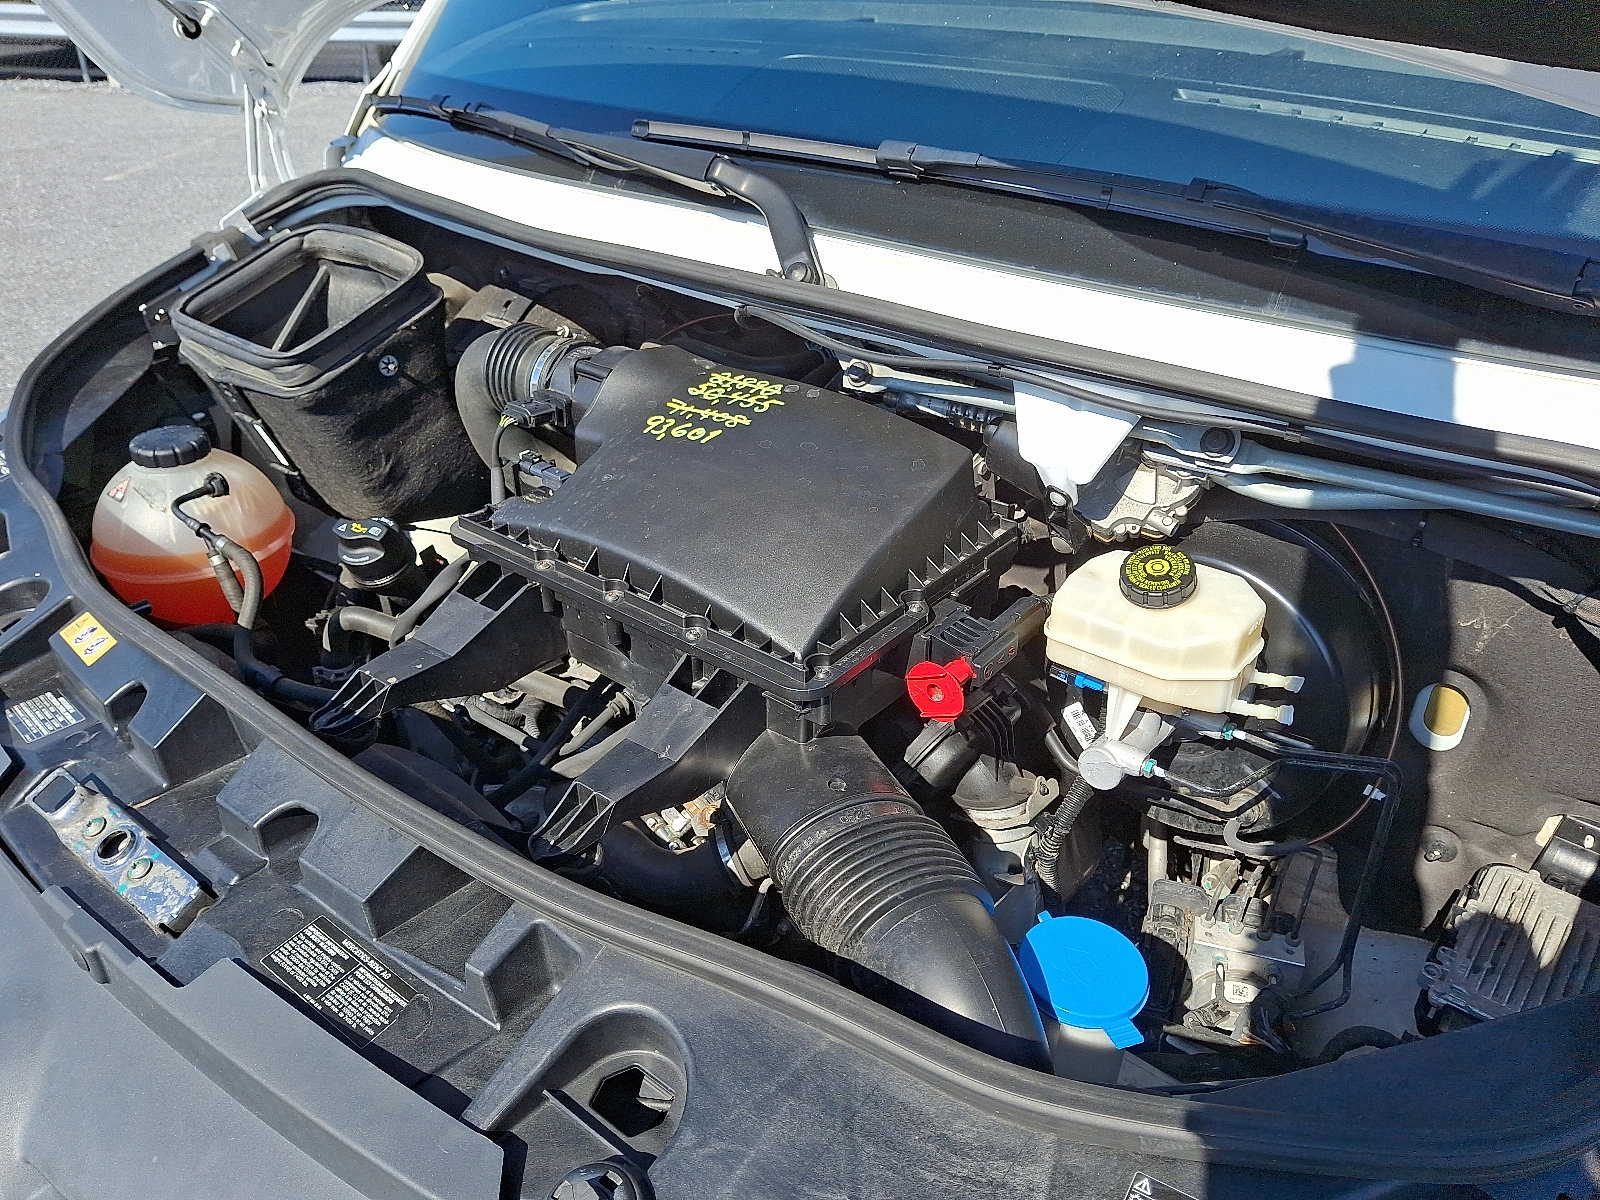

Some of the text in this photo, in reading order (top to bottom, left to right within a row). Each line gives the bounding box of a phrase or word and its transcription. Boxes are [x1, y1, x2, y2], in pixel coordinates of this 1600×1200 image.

[643, 415, 723, 444] 93,601
[340, 938, 392, 980] MERCEDES-BENZ AG
